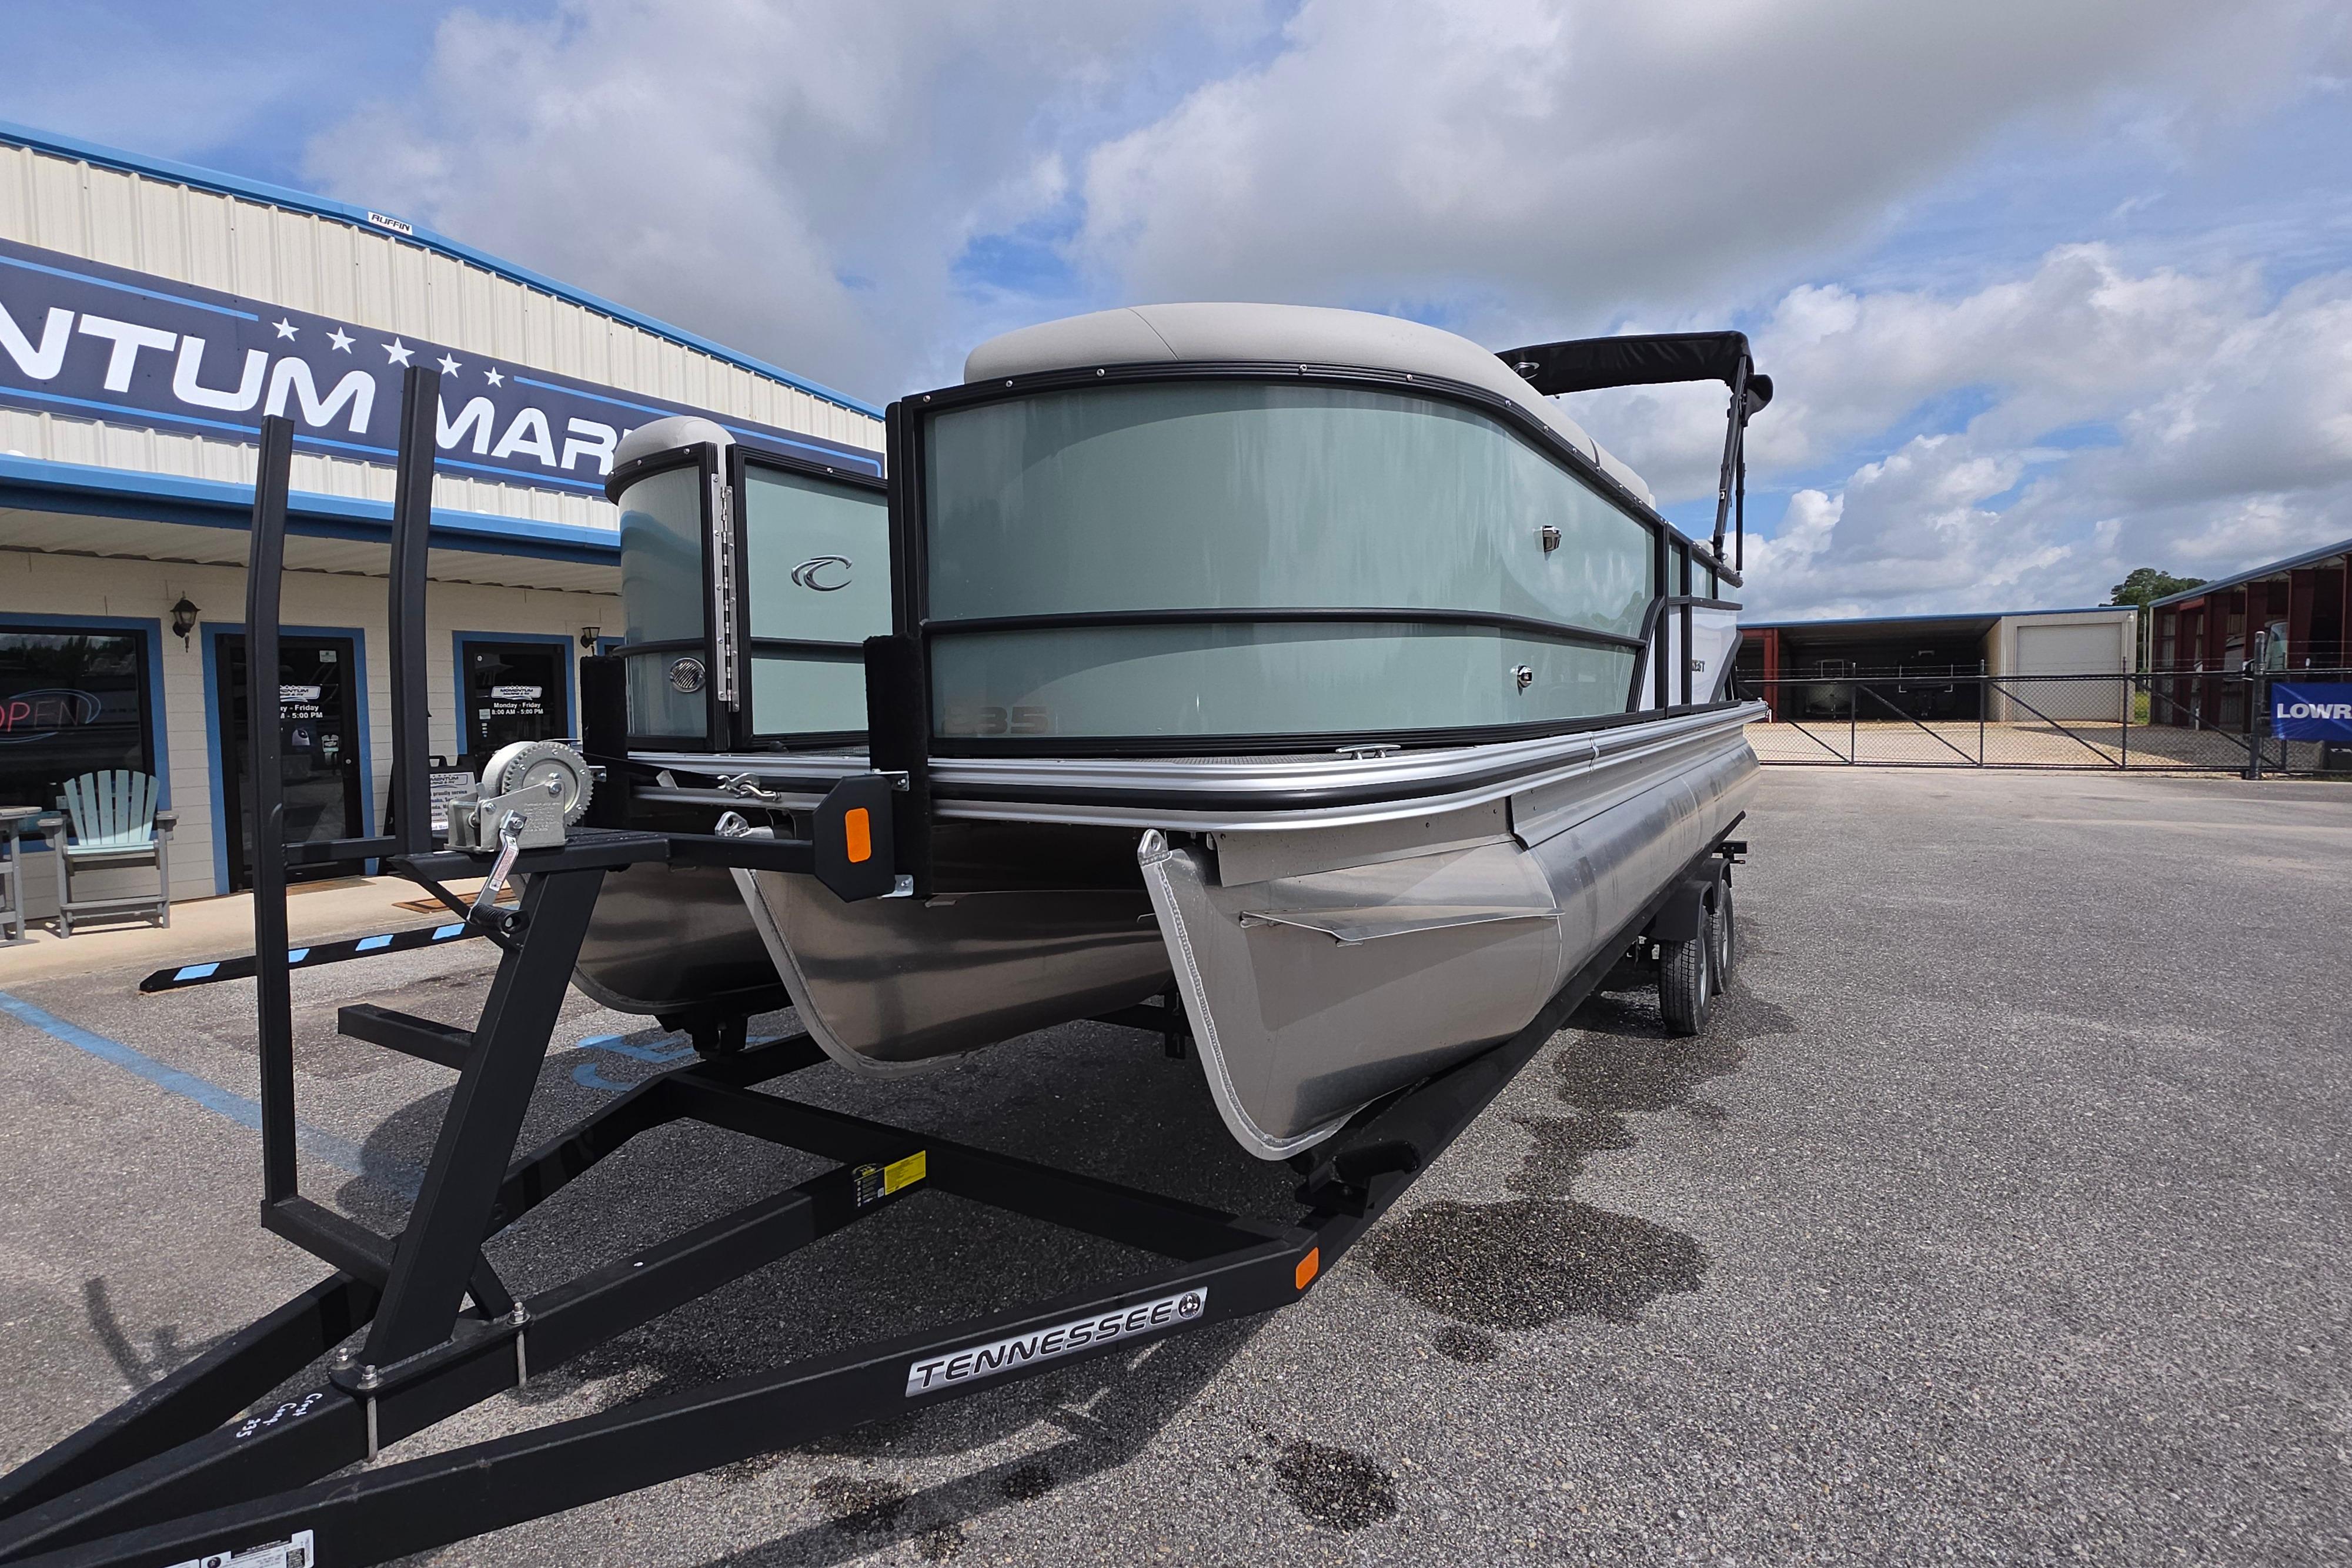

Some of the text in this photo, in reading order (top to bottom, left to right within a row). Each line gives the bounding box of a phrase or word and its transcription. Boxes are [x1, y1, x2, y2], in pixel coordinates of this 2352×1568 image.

[371, 214, 410, 232] RUFFIN
[436, 393, 633, 476] MAR
[0, 700, 81, 733] PEN
[2277, 703, 2352, 720] LOWR
[916, 1300, 1174, 1388] TENNESSEE
[236, 1418, 261, 1439] 235
